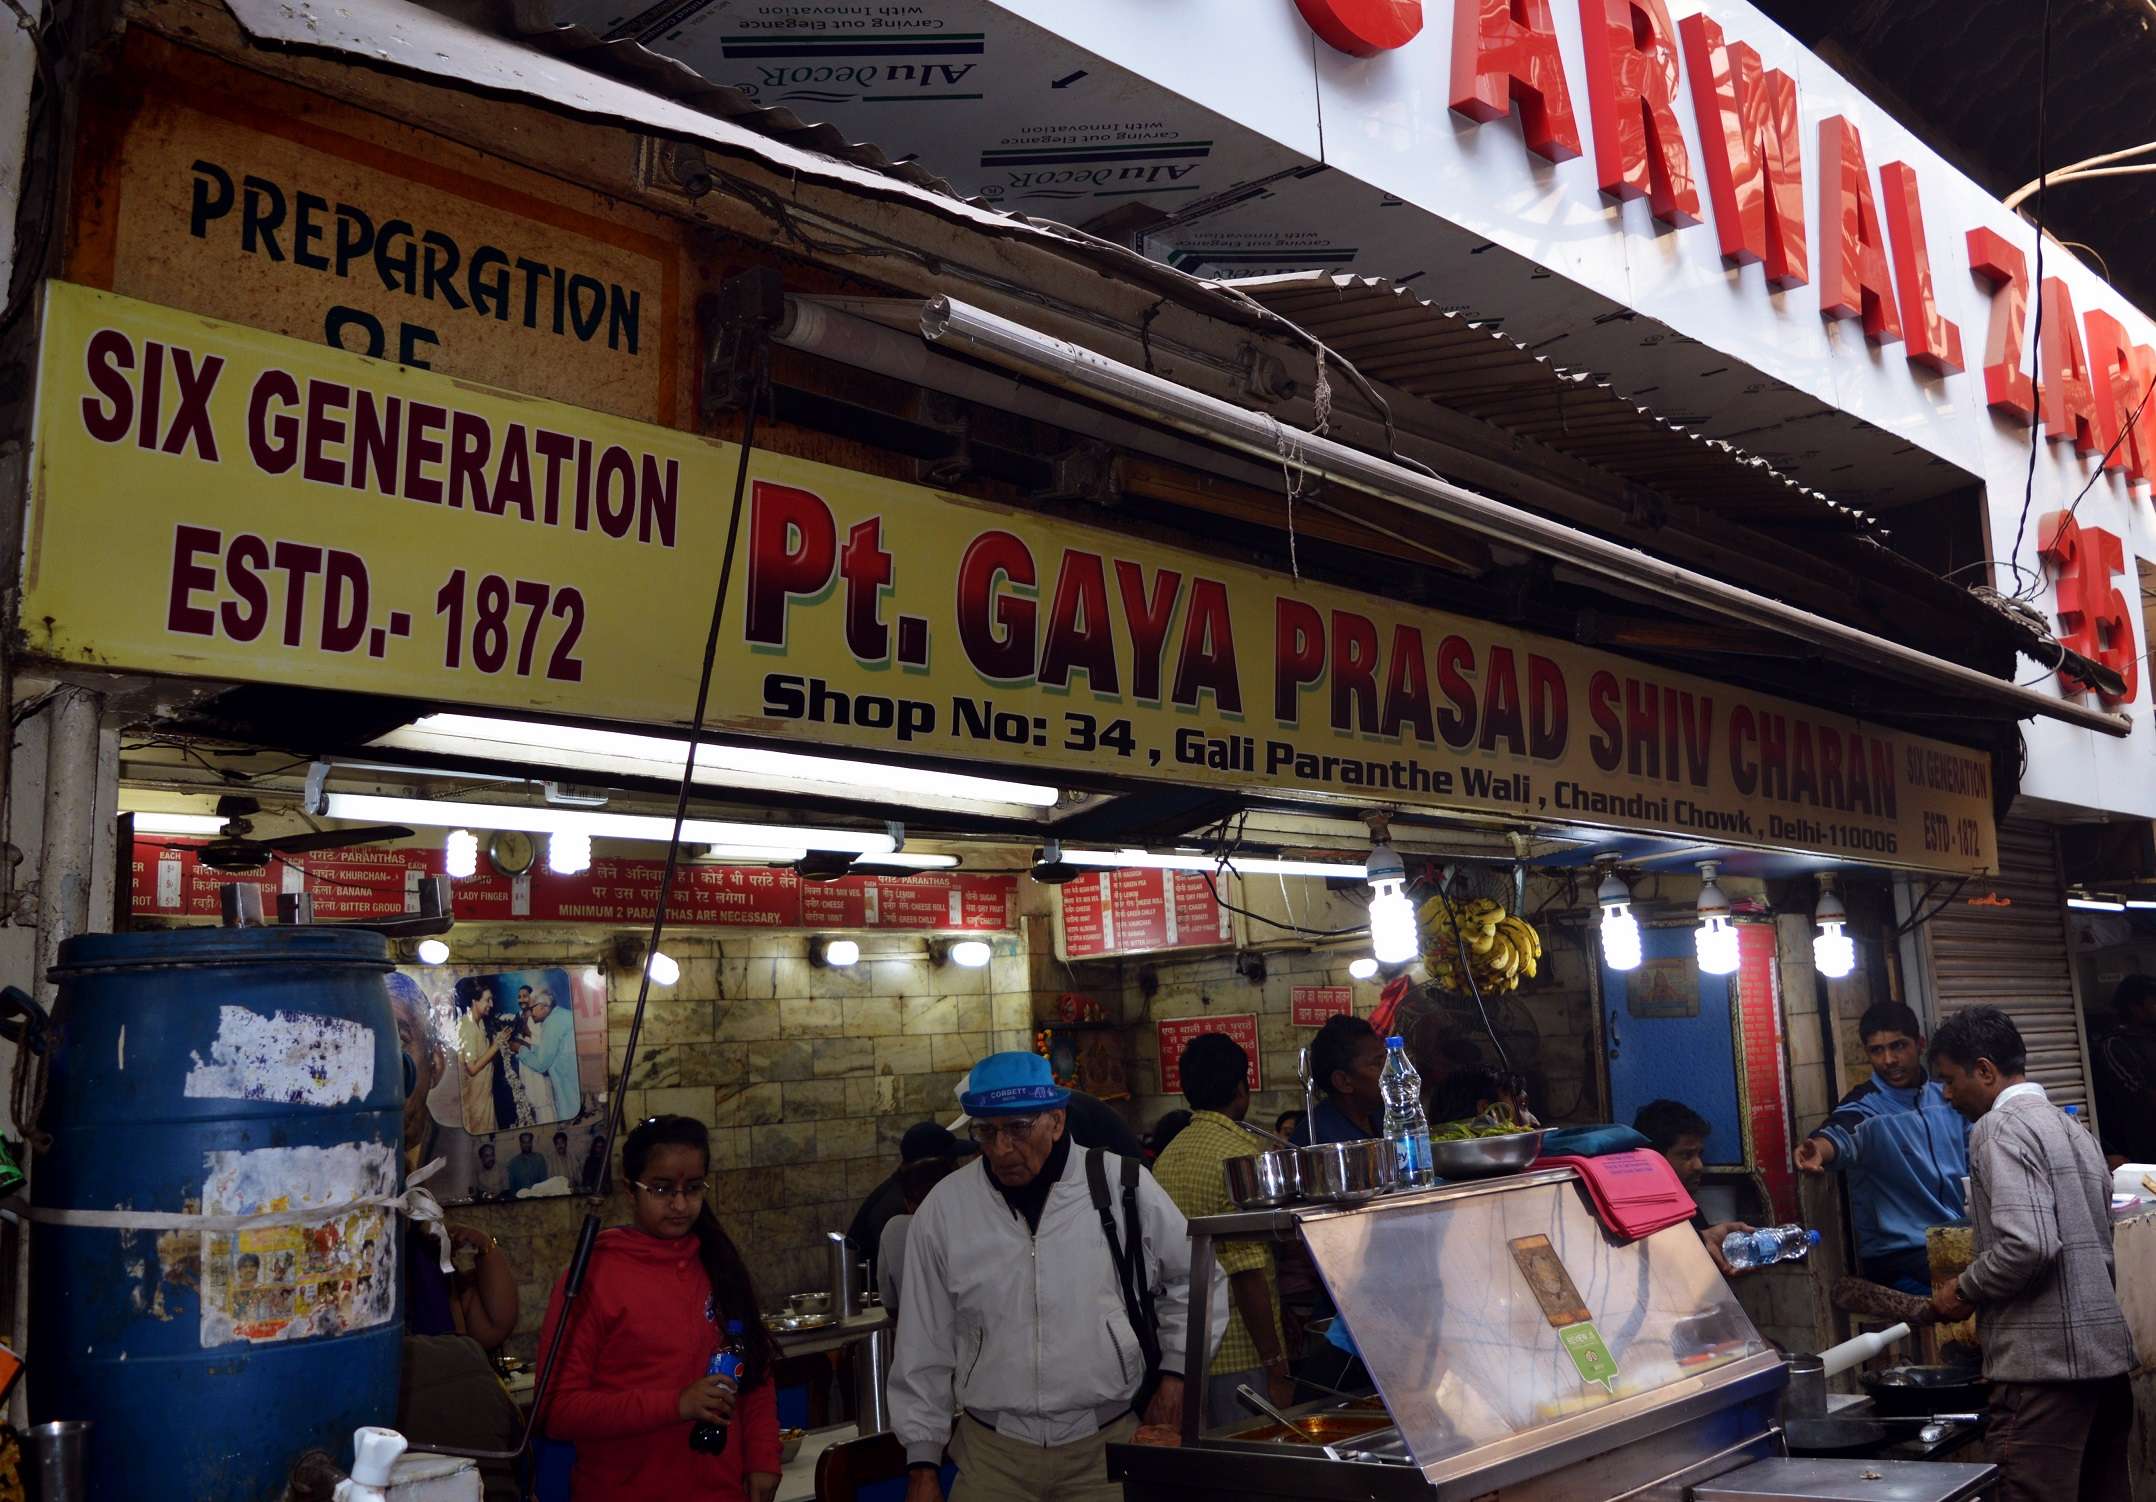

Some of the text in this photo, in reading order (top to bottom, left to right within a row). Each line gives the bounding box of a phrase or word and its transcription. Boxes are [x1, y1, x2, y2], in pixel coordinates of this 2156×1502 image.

[190, 159, 641, 356] PREPARATION
[82, 329, 681, 549] SIX GENERATION
[436, 568, 585, 683] 1872
[744, 479, 1898, 821] Pt. GAYA PRASAD SHIV CHARAN
[763, 673, 936, 741] Shop
[951, 696, 1047, 746] No:
[1175, 728, 1255, 772] Gali
[1266, 740, 1453, 795] Paranthe
[1554, 780, 1668, 823] Chandni
[1907, 744, 1988, 801] SIX GENERATION
[160, 851, 181, 860] EACH
[341, 851, 406, 864] PARANTHAS
[1958, 817, 1980, 857] 1872
[336, 886, 373, 897] BANANA
[340, 901, 370, 912] BITTER
[558, 903, 614, 919] MINIMUM
[616, 906, 624, 918] 2
[626, 907, 694, 921] PARATHAS
[696, 909, 718, 921] ARE
